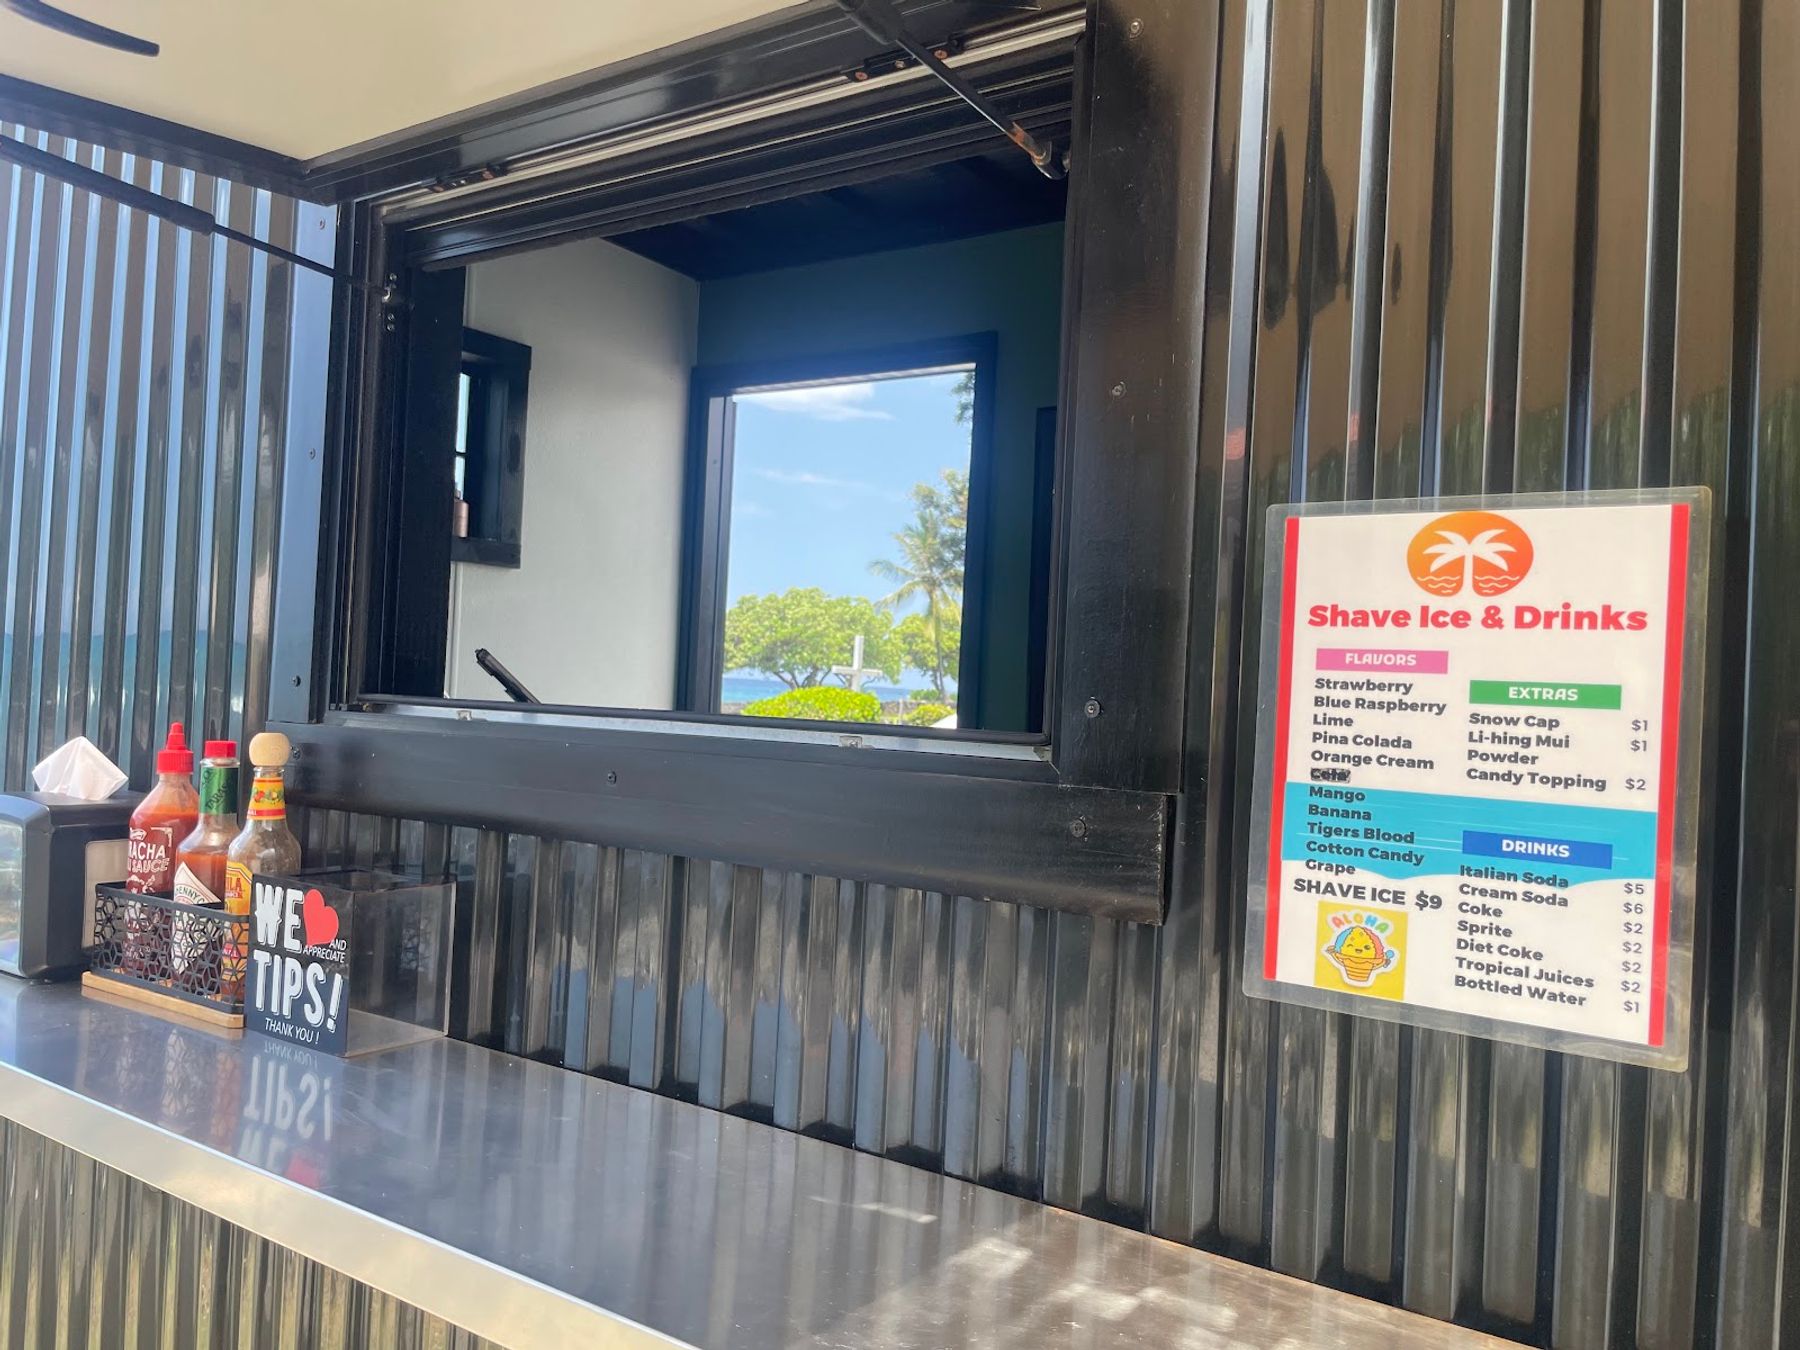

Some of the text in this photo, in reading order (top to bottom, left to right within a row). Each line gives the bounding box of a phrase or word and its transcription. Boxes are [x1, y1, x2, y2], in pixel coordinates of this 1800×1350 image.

[1308, 602, 1648, 631] Shave Ice & Drinks
[1345, 652, 1417, 666] FLAVORS
[1314, 677, 1413, 695] Strawberry
[1508, 686, 1578, 701] EXTRAS
[1314, 695, 1447, 716] Blue Raspberry
[1313, 713, 1354, 727] Lime
[1468, 712, 1560, 731] Snow Cap
[1631, 719, 1648, 732] $1
[1312, 730, 1413, 749] Pina Colada
[1468, 731, 1570, 749] Li-hing Mui
[1630, 739, 1648, 752] $1
[1310, 750, 1434, 770] Orange Cream
[1467, 749, 1539, 765] Powder
[1466, 768, 1607, 792] Candy Topping
[1625, 777, 1646, 791] $2
[1309, 786, 1366, 803] Mango
[1308, 804, 1372, 821] Banana
[1307, 822, 1415, 844] Tigers Blood
[1306, 840, 1425, 867] Cotton Candy
[1501, 838, 1571, 858] DRINKS
[132, 857, 170, 873] SAUCE
[1305, 858, 1356, 876] Grape
[1459, 864, 1569, 889] Italian Soda
[1293, 878, 1443, 911] SHAVE ICE $9
[1458, 883, 1569, 907] Cream Soda
[1623, 882, 1645, 895] $5
[254, 882, 304, 953] WE
[1458, 901, 1503, 918] Coke
[1623, 902, 1644, 915] $6
[1331, 912, 1391, 934] ALOHA
[1457, 920, 1513, 938] Sprite
[1623, 921, 1643, 934] $2
[302, 944, 345, 963] APPRECIATE
[328, 938, 347, 951] AND
[1456, 938, 1544, 961] Diet Coke
[1622, 941, 1642, 954] $2
[1455, 956, 1595, 988] Tropical Juices
[1621, 960, 1641, 974] $2
[253, 949, 343, 1034] TIPS!
[1454, 975, 1587, 1006] Bottled Water
[1620, 980, 1641, 994] $2
[1623, 1000, 1640, 1013] $1
[265, 1018, 294, 1037] THANK
[295, 1026, 314, 1044] YOU
